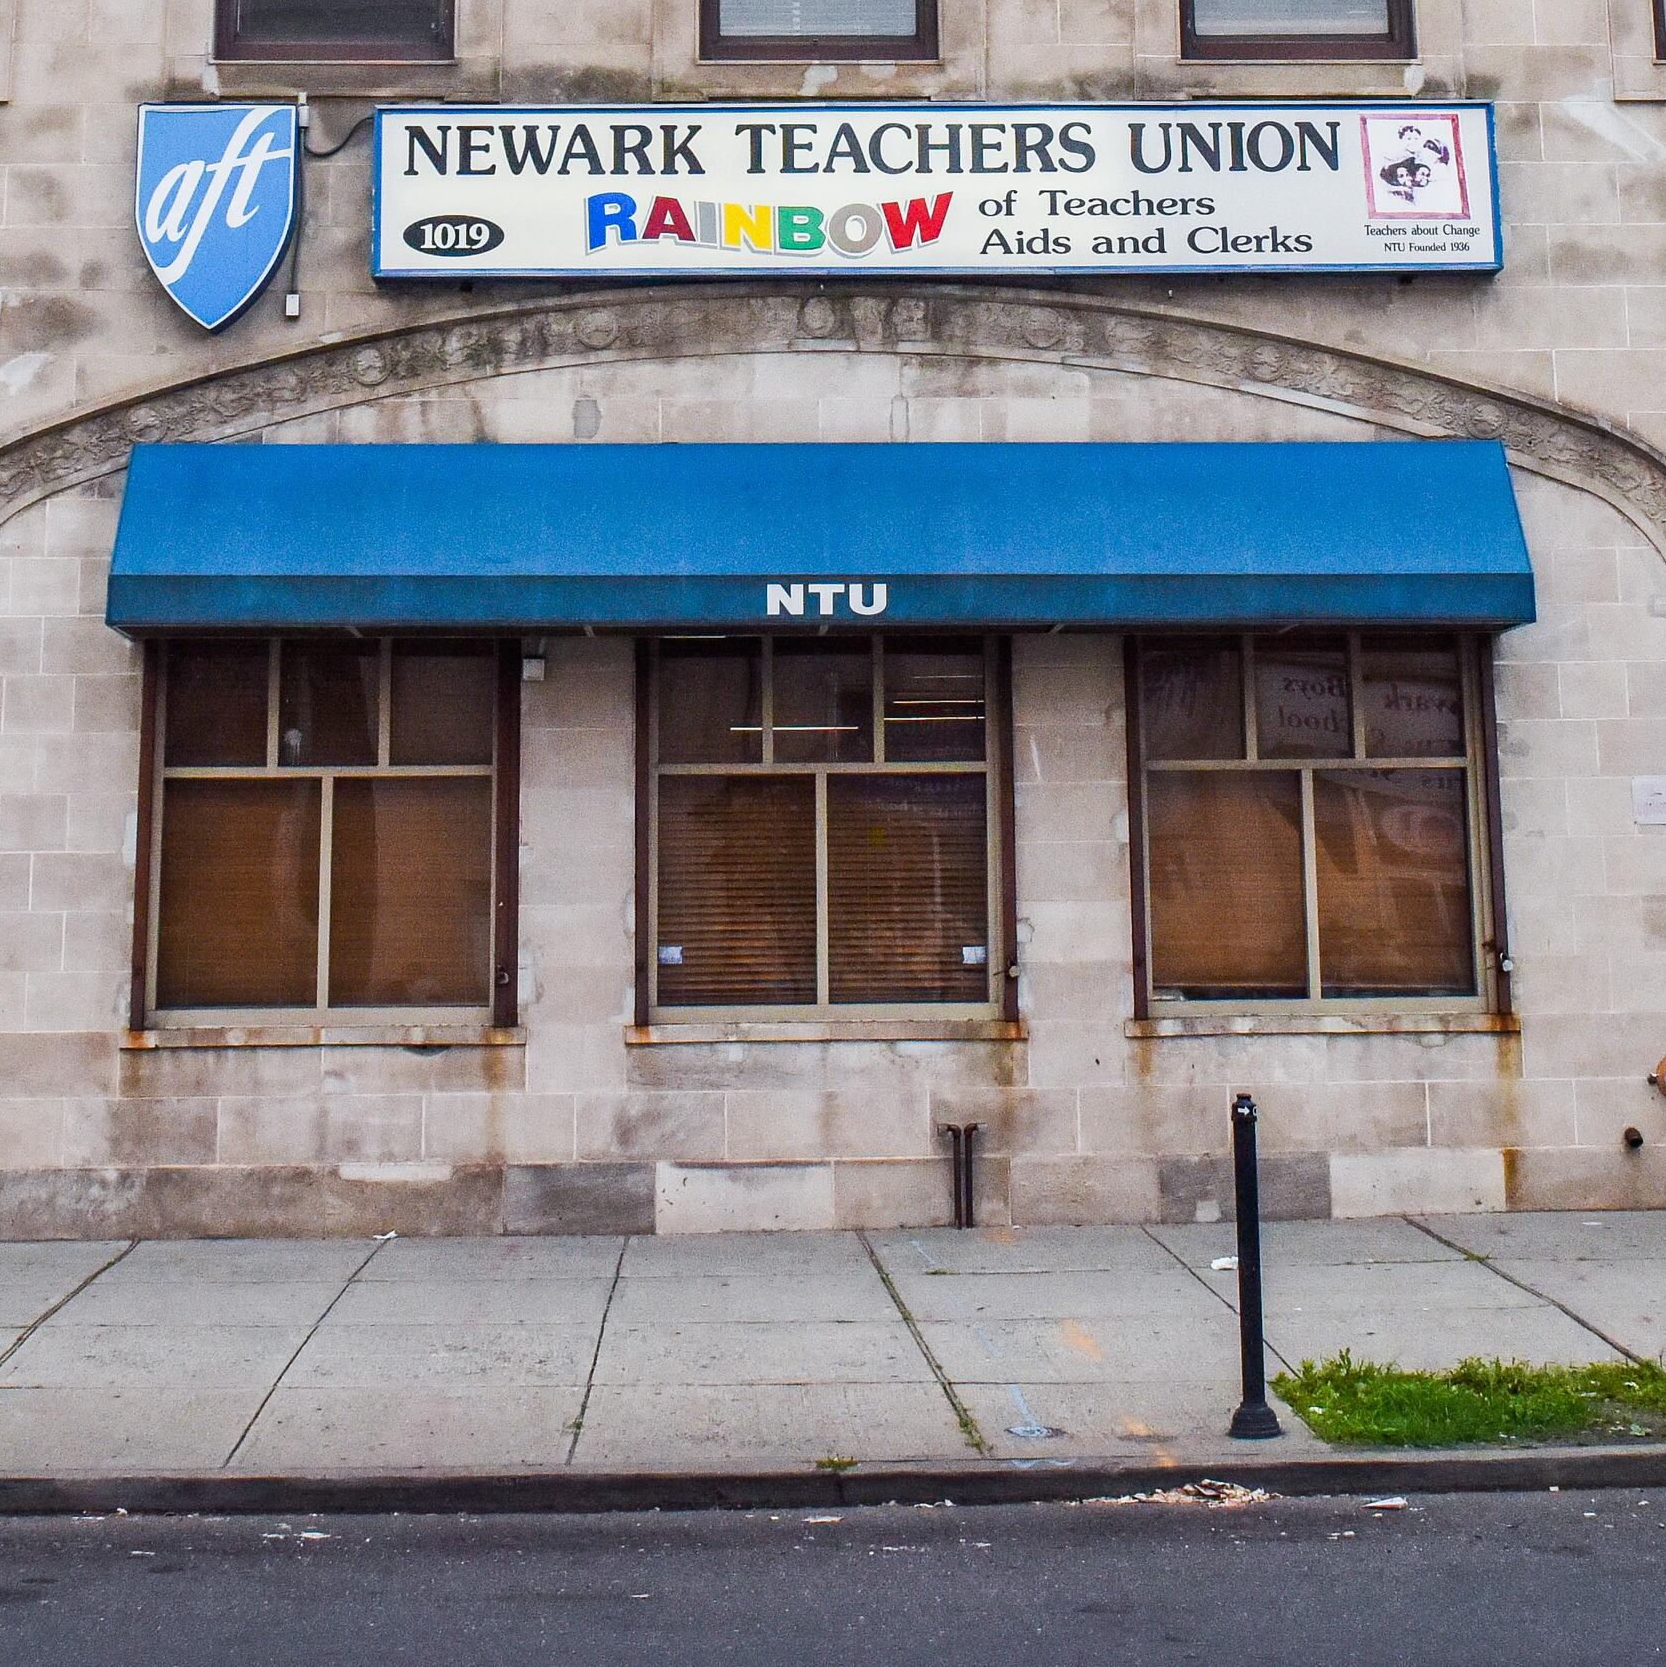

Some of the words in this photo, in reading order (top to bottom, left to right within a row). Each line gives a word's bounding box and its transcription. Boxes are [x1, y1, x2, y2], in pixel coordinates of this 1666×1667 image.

[404, 124, 706, 176] NEWARK
[735, 122, 1096, 175] TEACHERS
[1129, 120, 1341, 173] UNION
[145, 107, 294, 285] aft
[978, 190, 1019, 218] of
[1039, 189, 1216, 217] Teachers
[419, 223, 490, 251] 1019
[584, 191, 953, 259] RAINBOW
[979, 228, 1086, 256] Aids
[1091, 227, 1174, 254] and
[1187, 225, 1313, 254] Clerks
[1364, 224, 1407, 236] Teachers
[1411, 224, 1438, 236] about
[1442, 223, 1481, 237] Change
[1384, 242, 1405, 252] NTU
[1409, 242, 1446, 252] Founded
[1450, 241, 1470, 252] 1936
[766, 583, 887, 616] NTU
